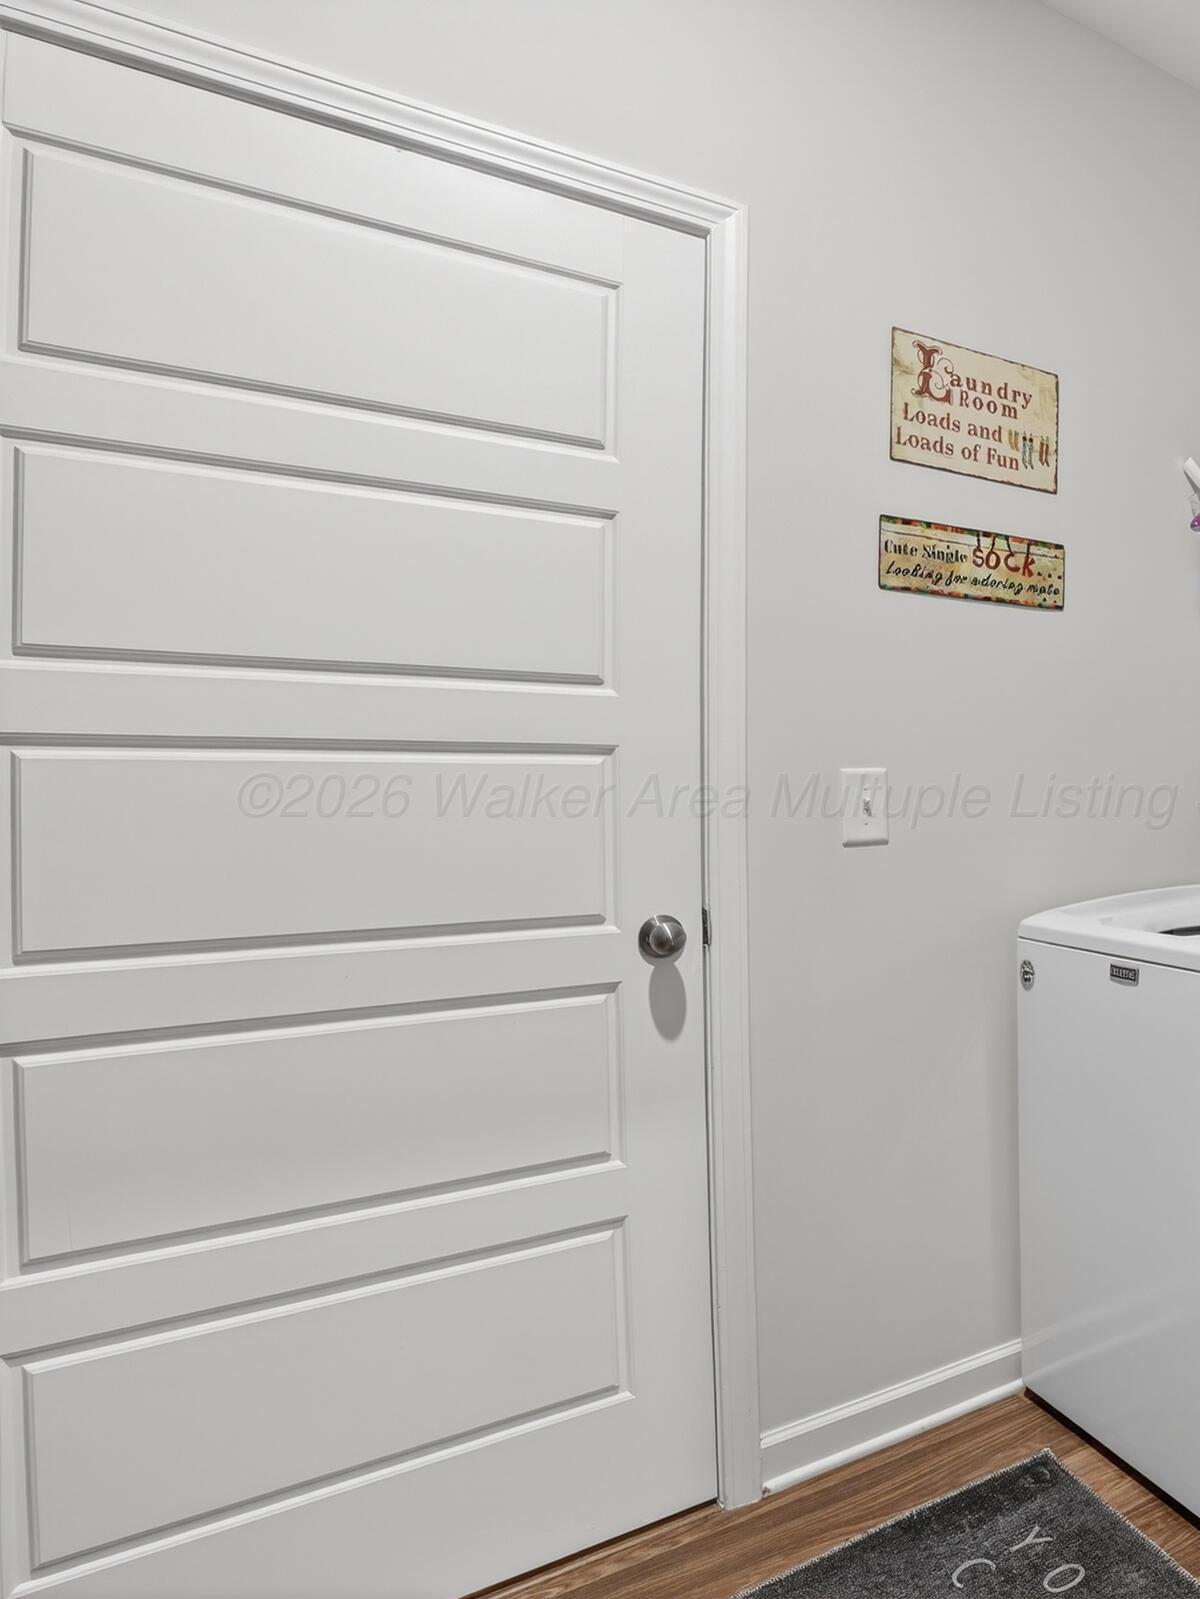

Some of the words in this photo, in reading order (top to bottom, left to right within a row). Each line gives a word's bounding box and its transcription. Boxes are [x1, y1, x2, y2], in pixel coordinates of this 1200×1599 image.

[911, 340, 1032, 410] Laundry
[903, 402, 961, 433] Loads
[967, 425, 1003, 443] and
[959, 389, 1018, 420] Room
[895, 426, 954, 456] Loads
[961, 444, 981, 462] of
[987, 447, 1019, 471] Fun
